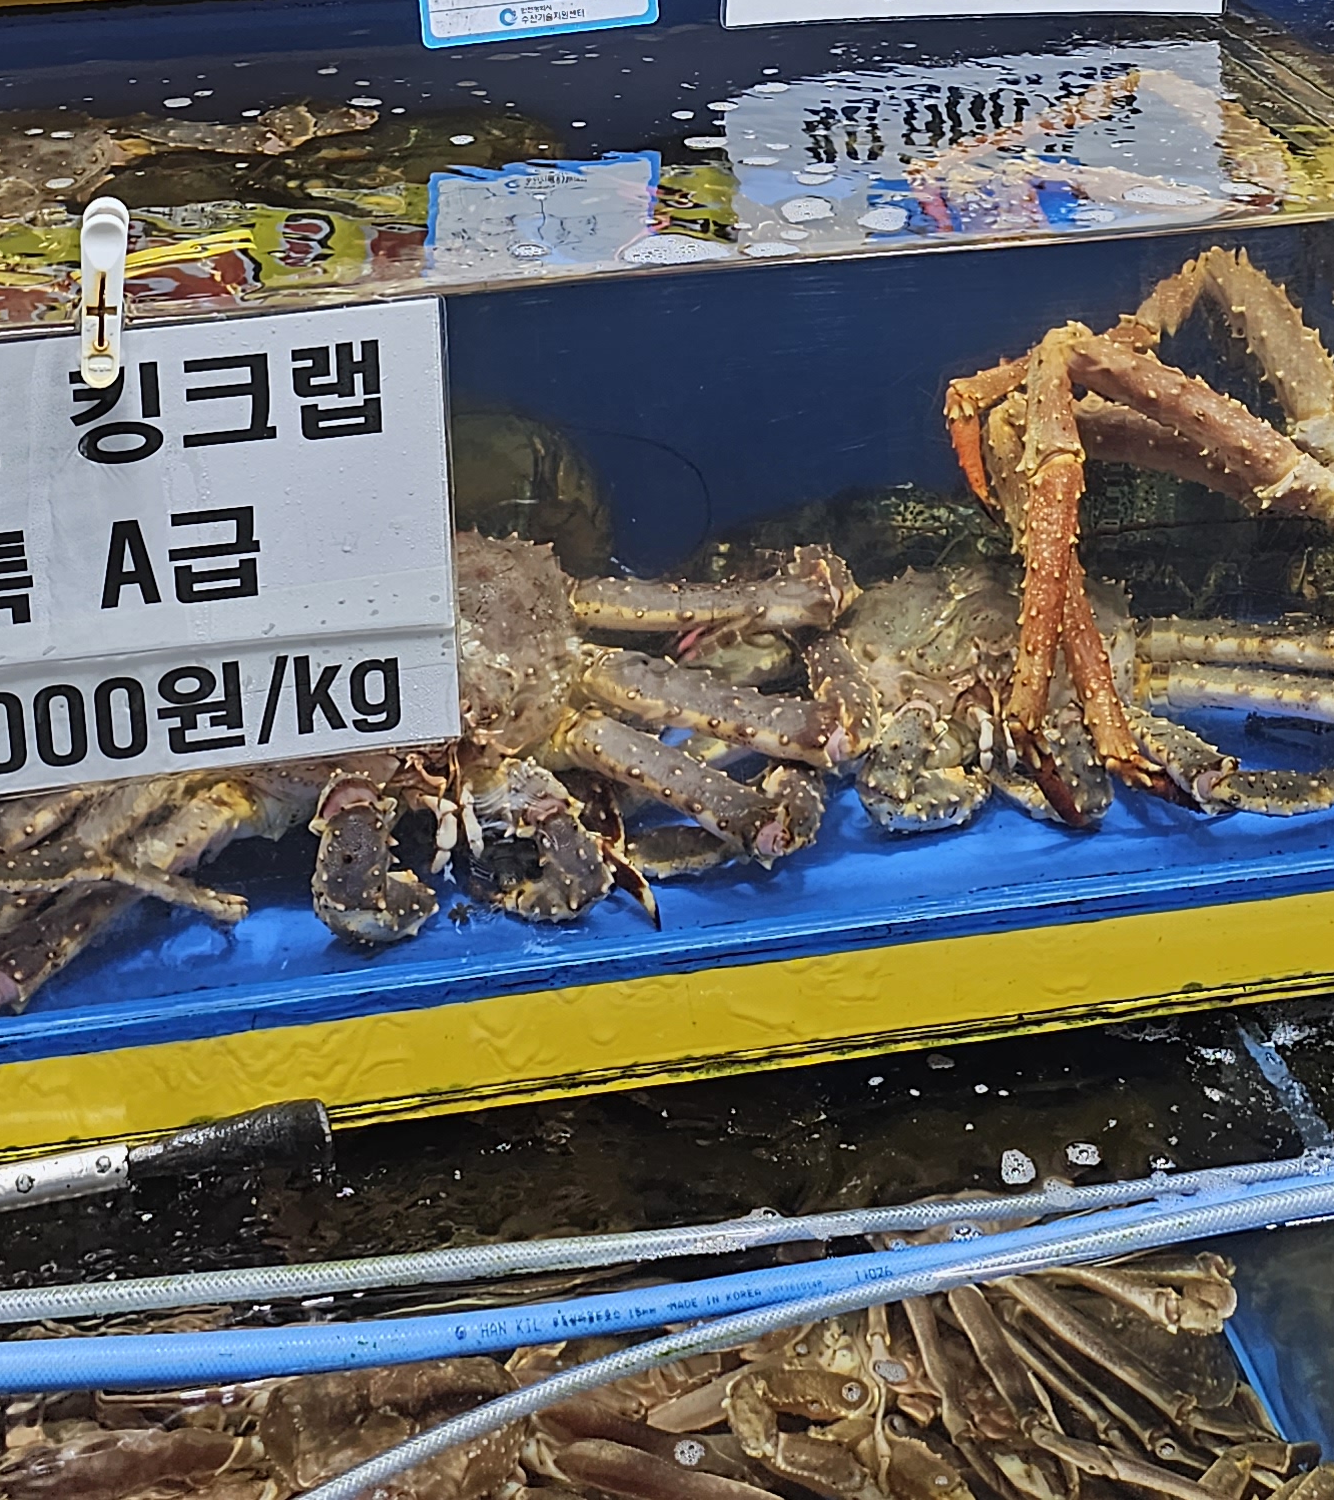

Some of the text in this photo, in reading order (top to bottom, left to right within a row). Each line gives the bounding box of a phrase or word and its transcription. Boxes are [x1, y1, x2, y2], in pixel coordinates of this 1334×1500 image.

[521, 8, 585, 25] 수산기술지원센터
[68, 339, 384, 465] 킹크랩
[101, 505, 261, 610] A급
[481, 1320, 508, 1338] HAN
[669, 1298, 698, 1311] MADE
[707, 1291, 720, 1306] IN
[726, 1289, 763, 1303] KOREA
